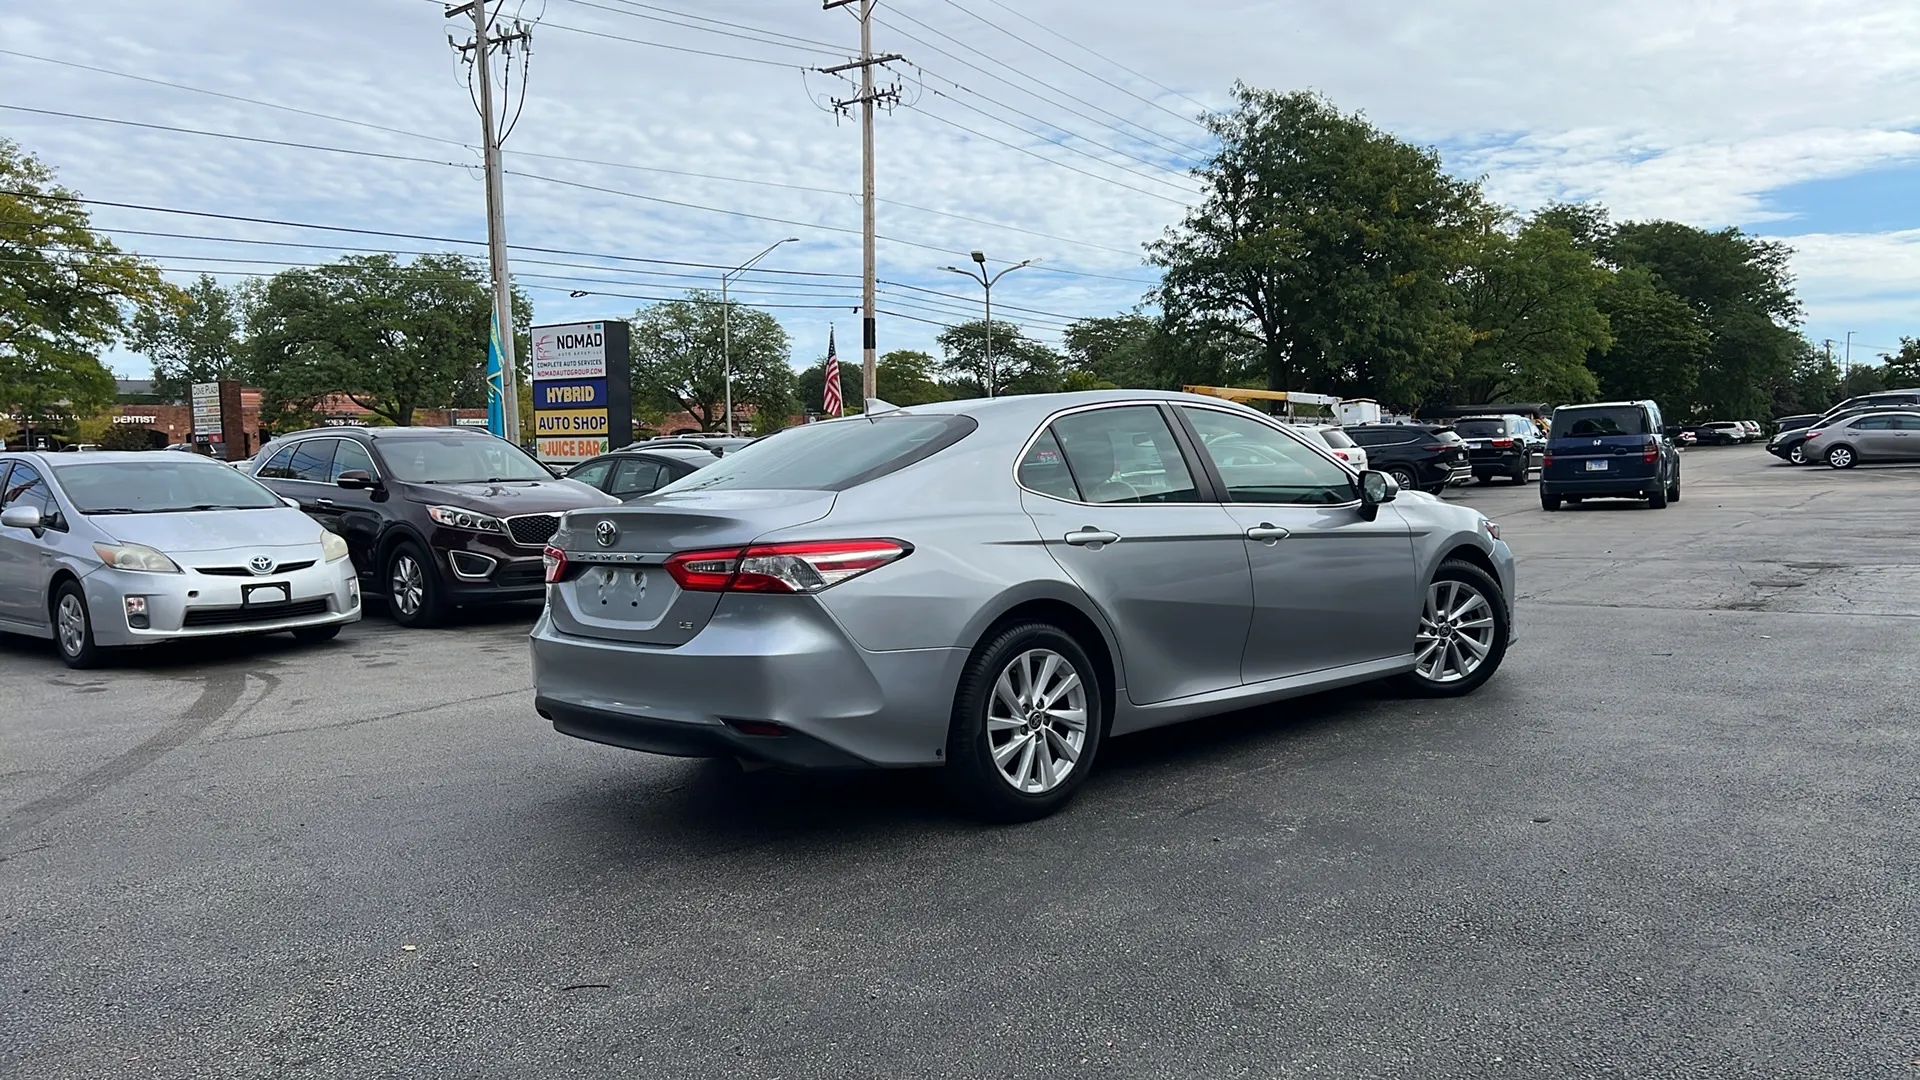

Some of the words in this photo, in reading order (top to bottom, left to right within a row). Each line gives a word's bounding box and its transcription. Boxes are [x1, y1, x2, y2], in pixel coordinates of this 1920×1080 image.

[557, 334, 602, 349] NOMAD
[537, 368, 603, 377] NOMADAUTOGROUP.COM
[547, 386, 594, 403] HYBRID
[113, 415, 156, 424] DENTIST
[538, 416, 570, 430] AUTO
[573, 416, 607, 430] SHOP
[545, 441, 576, 457] JUICE
[578, 440, 601, 456] BAR
